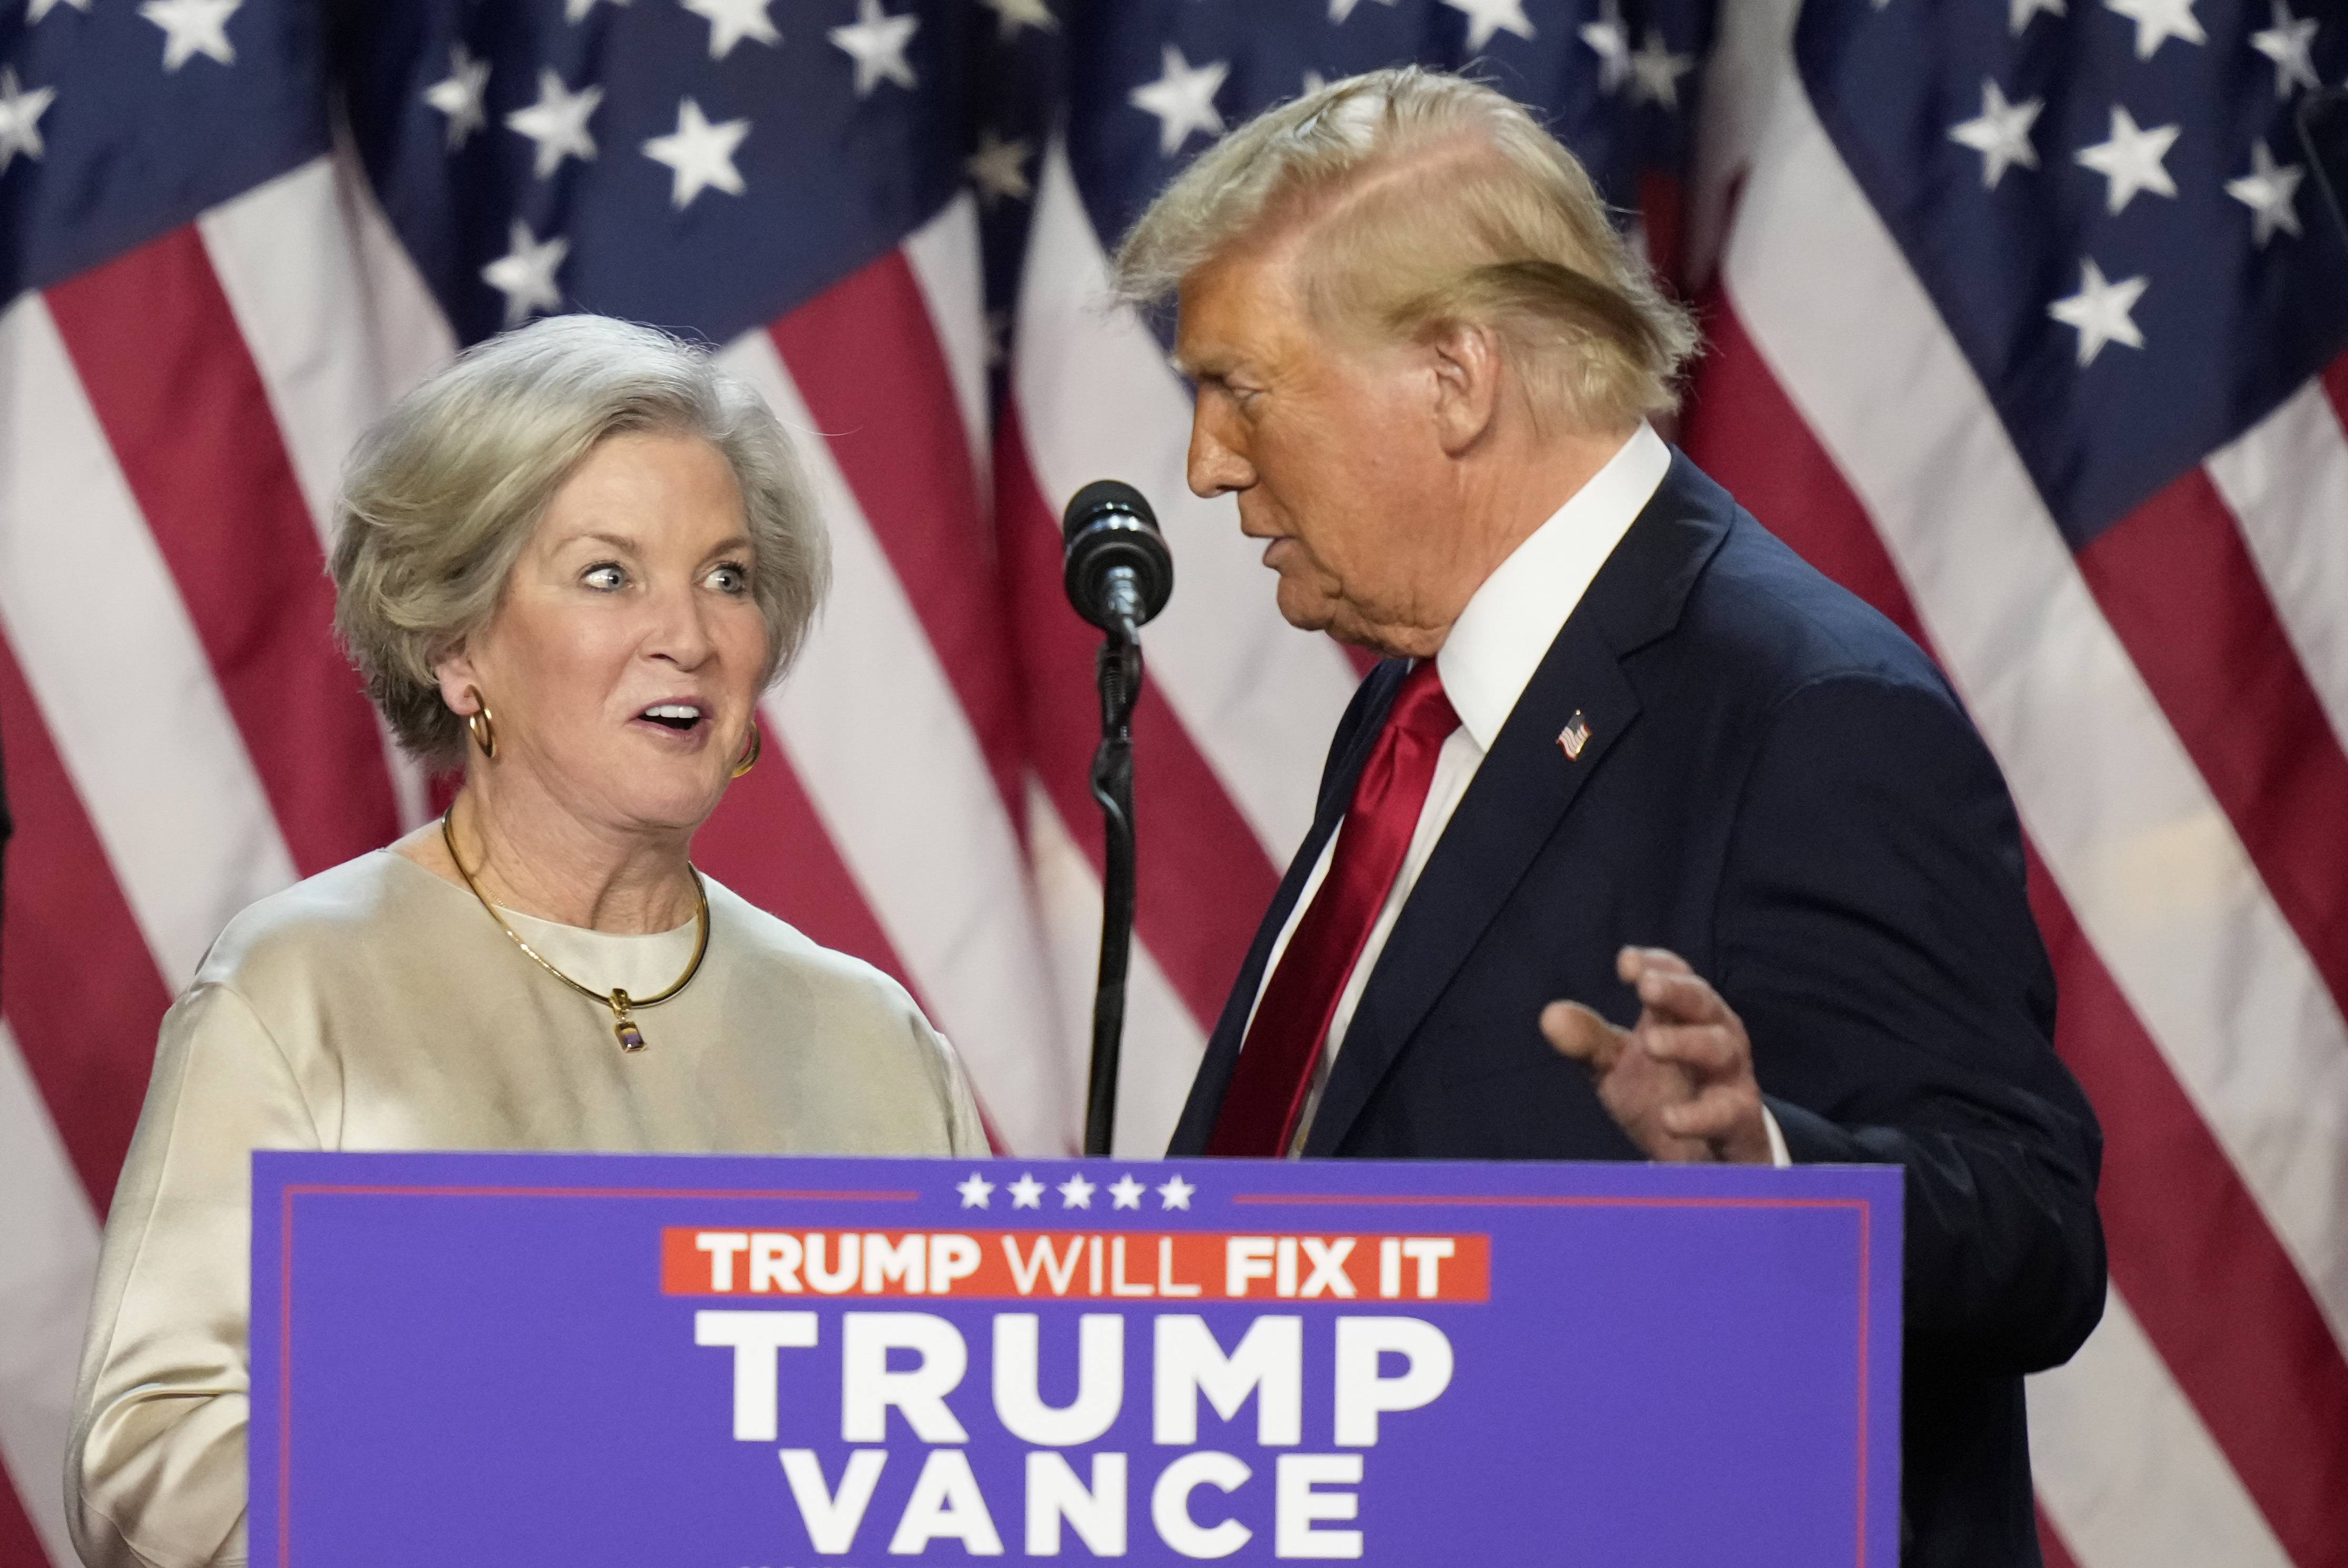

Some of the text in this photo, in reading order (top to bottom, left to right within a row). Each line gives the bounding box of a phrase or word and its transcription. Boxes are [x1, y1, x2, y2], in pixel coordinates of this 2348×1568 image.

[695, 1232, 1455, 1298] TRUMP WILL FIX IT
[694, 1310, 1454, 1447] TRUMP
[778, 1449, 1364, 1560] VANCE
